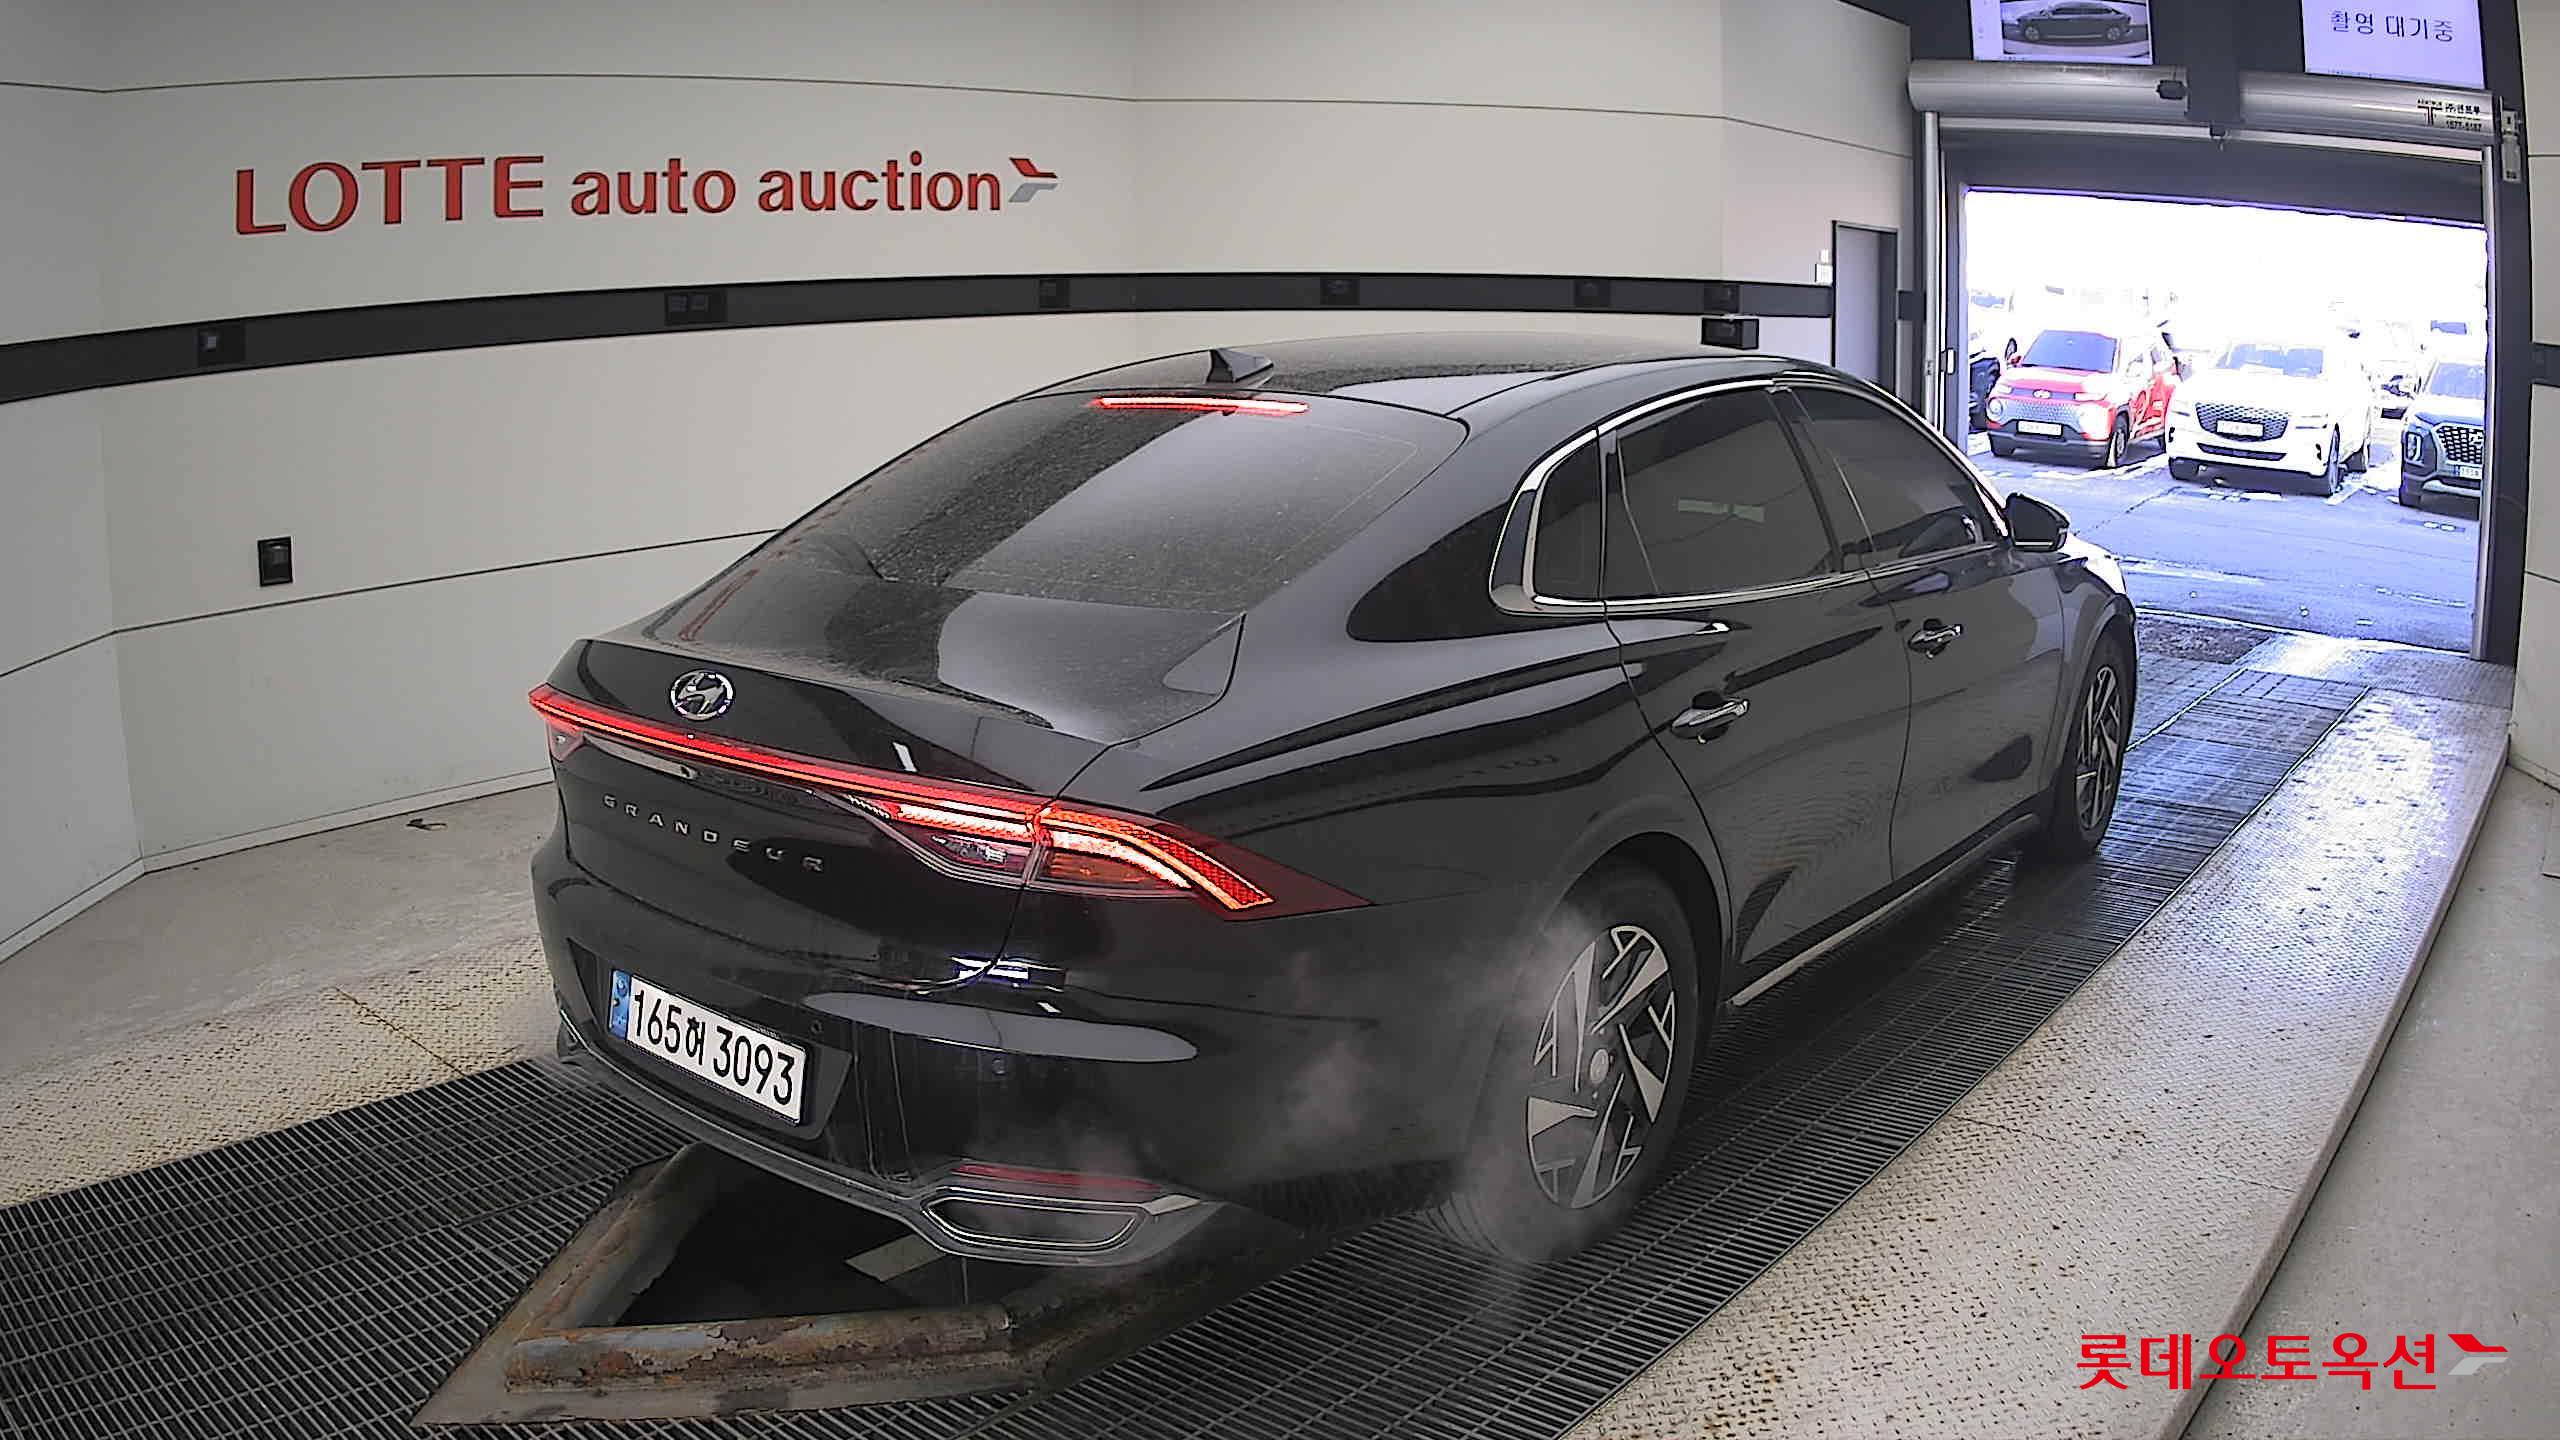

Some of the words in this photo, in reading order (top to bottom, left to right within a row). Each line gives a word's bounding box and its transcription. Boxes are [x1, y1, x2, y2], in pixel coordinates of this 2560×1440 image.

[2331, 10, 2374, 35] 촬영
[2385, 15, 2453, 42] 대기중
[235, 155, 544, 236] LOTTE
[570, 157, 737, 216] auto
[757, 151, 1001, 213] auction
[603, 794, 824, 873] GRANDEUR
[634, 989, 706, 1066] 165허
[713, 1024, 795, 1106] 3093
